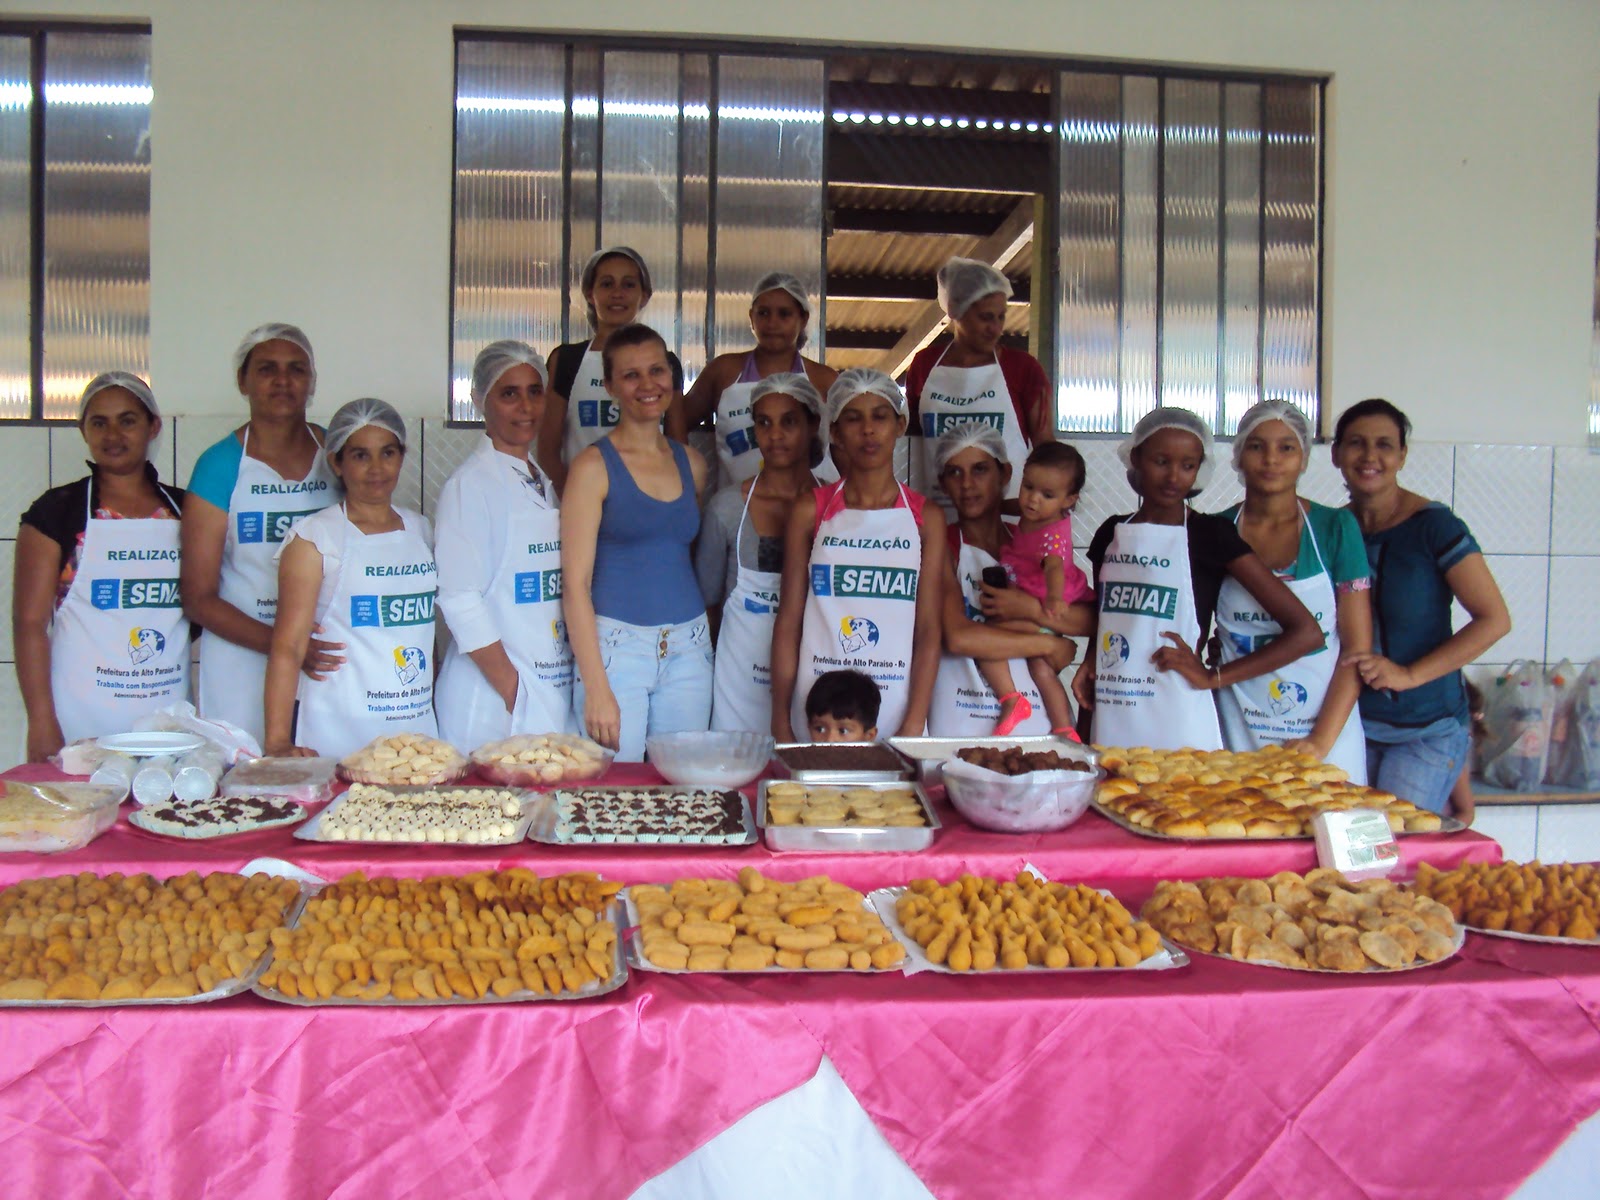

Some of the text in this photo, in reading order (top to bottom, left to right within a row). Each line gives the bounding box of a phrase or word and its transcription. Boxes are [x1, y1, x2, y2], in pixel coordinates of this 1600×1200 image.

[528, 541, 562, 554] REALIZ
[822, 536, 911, 551] REALIZAÇÃO
[107, 550, 182, 562] REALIZAÇ
[841, 569, 913, 596] SENAI
[130, 583, 182, 604] SENA
[1108, 586, 1170, 614] SENAI
[813, 656, 842, 666] Prefeitura
[96, 666, 129, 677] Prefeitura
[96, 680, 124, 688] Trabalho
[367, 690, 400, 699] Prefeitura
